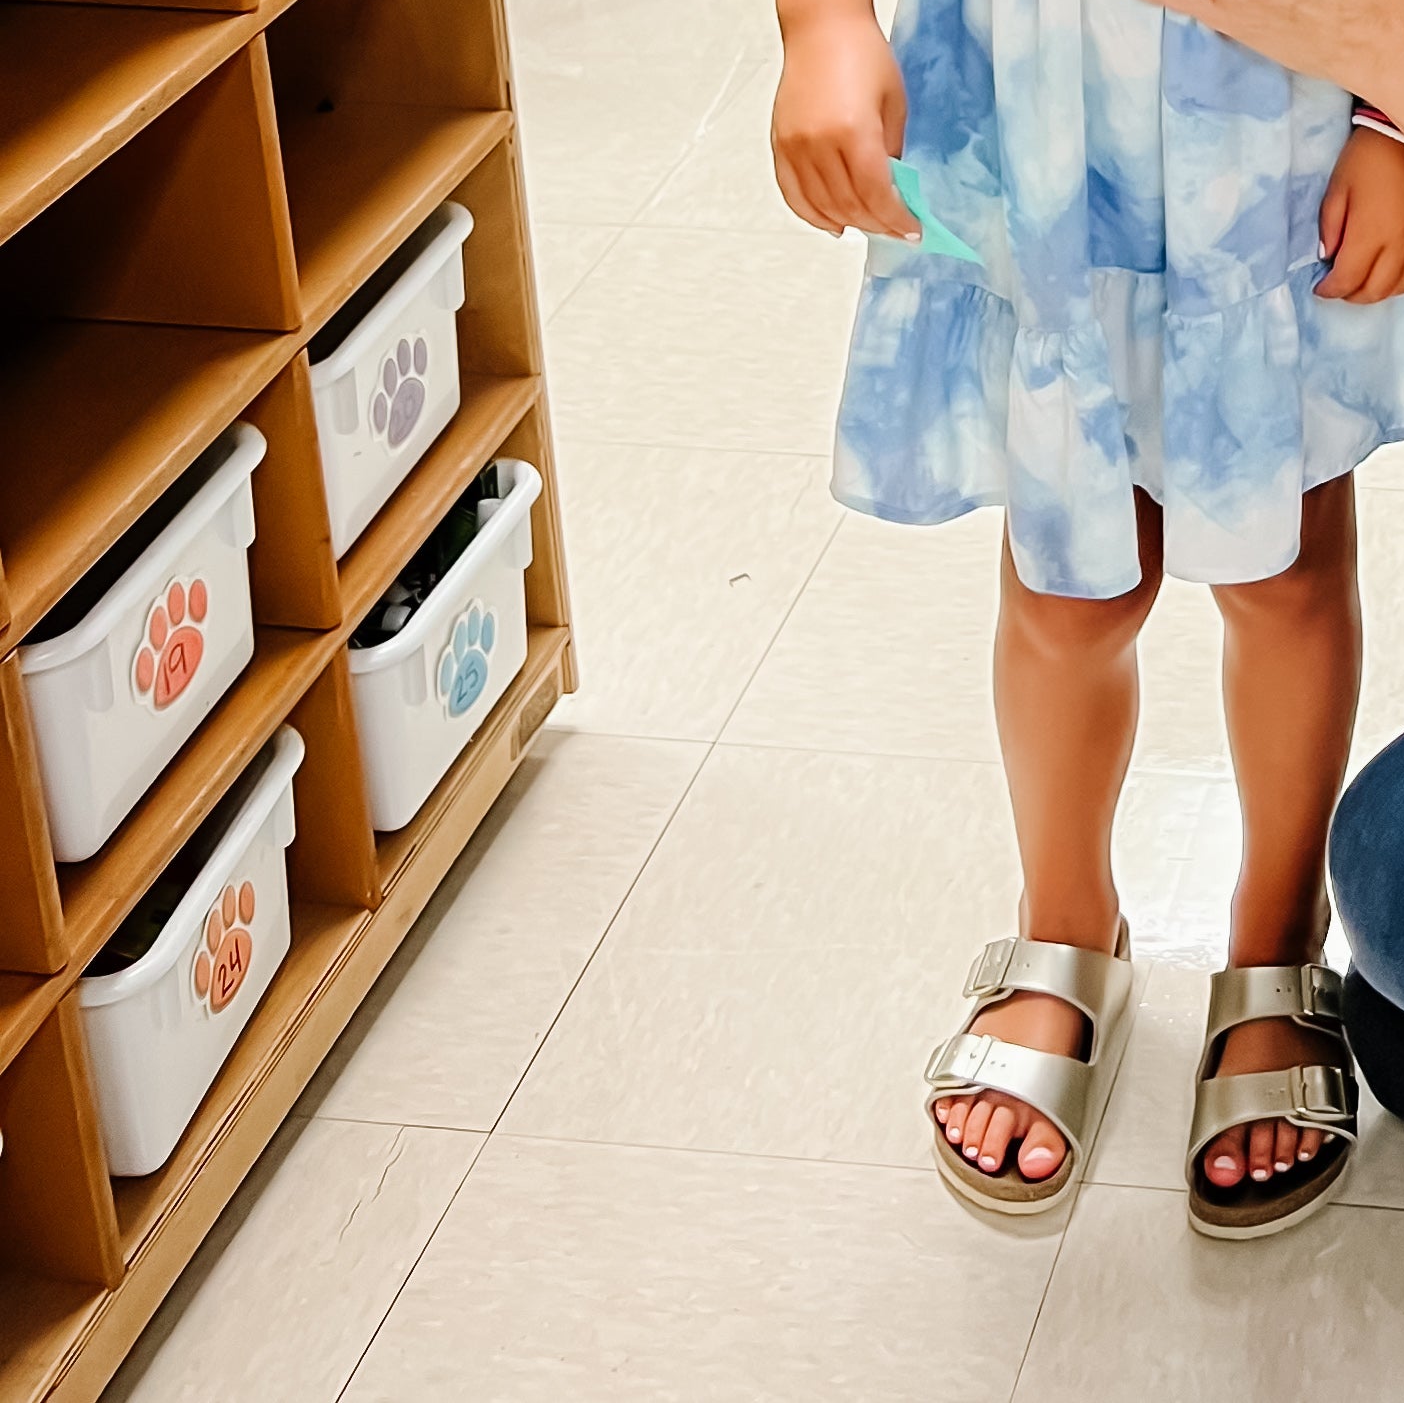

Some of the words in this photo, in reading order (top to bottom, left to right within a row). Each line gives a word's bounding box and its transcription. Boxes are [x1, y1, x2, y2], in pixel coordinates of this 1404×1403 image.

[163, 642, 188, 696] 19
[455, 660, 480, 705] 25
[217, 937, 242, 998] 24
